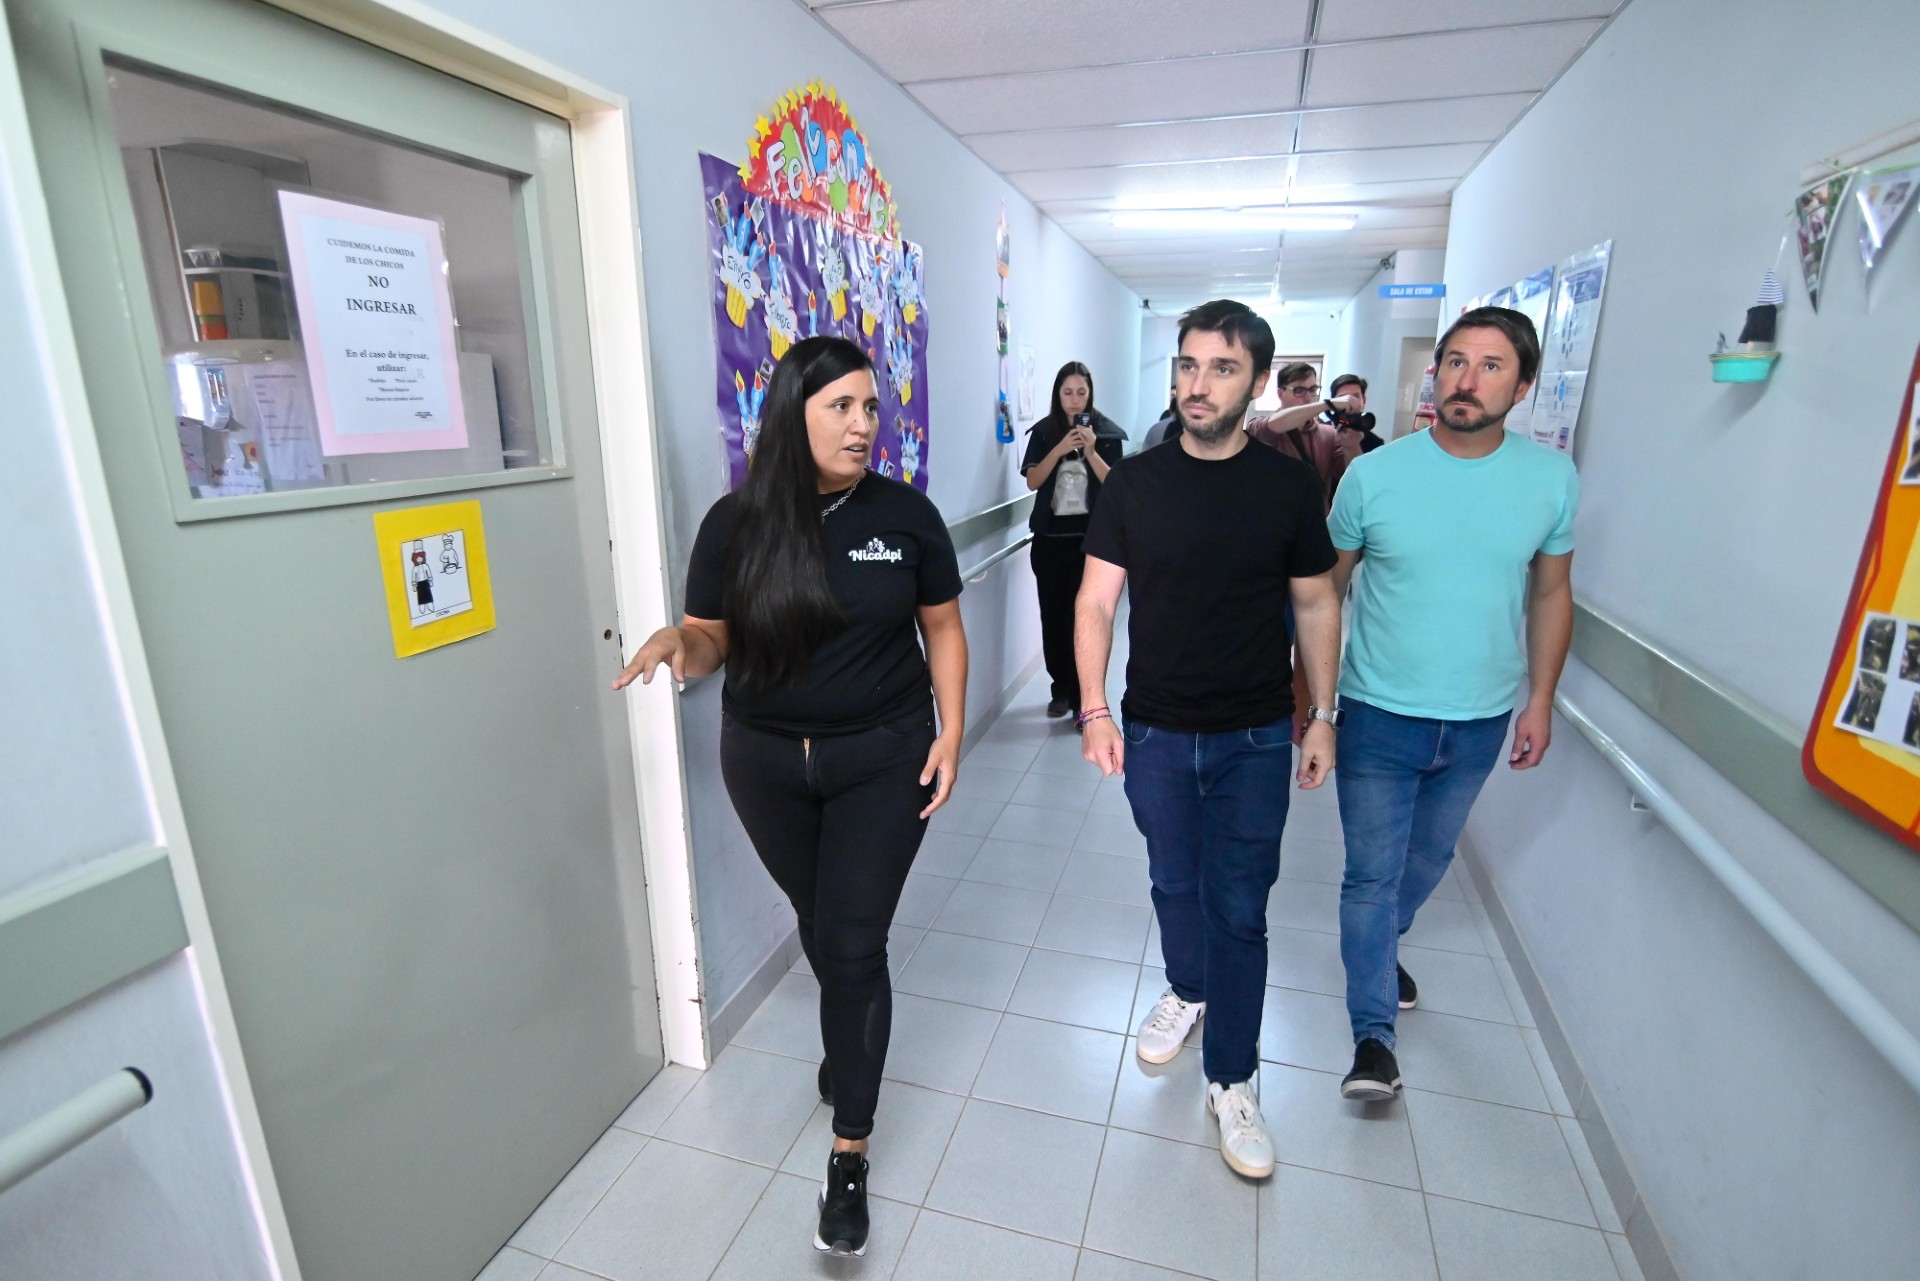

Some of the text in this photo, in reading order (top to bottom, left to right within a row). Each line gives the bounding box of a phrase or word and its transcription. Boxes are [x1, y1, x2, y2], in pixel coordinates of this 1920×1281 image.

[327, 238, 415, 258] CUIDEMOS LA COMIDA
[345, 255, 405, 270] DE LOS CHICOS
[368, 275, 389, 288] NO
[346, 298, 417, 315] INGRESAR
[345, 349, 430, 361] En el caso de ingresar,
[848, 548, 902, 563] Nicadpi
